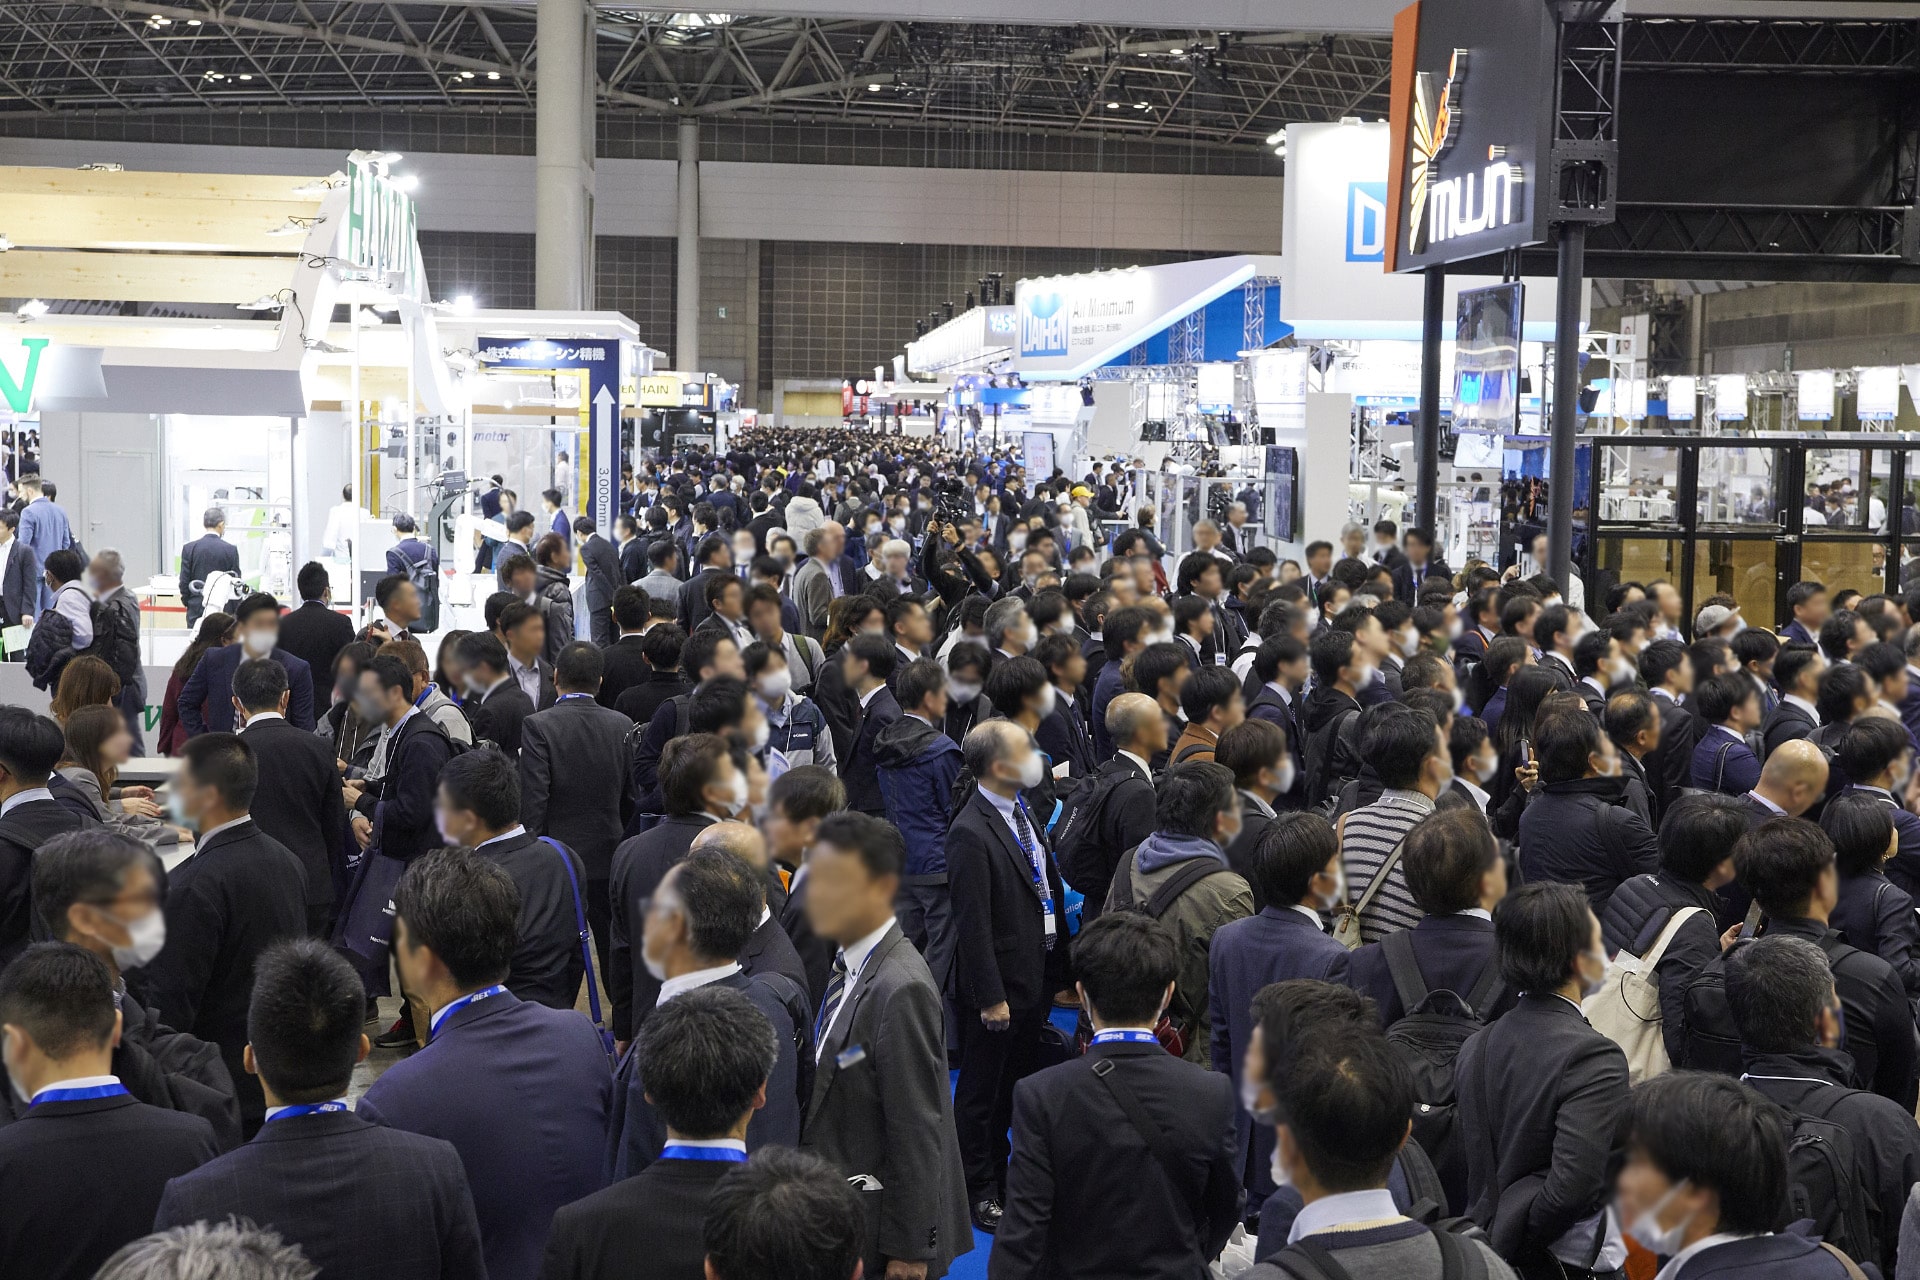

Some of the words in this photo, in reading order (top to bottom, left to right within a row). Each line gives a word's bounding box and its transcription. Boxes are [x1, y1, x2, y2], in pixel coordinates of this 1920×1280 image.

[1022, 300, 1068, 352] DAIHEN
[473, 430, 510, 442] motor
[598, 467, 610, 527] 3,000mm
